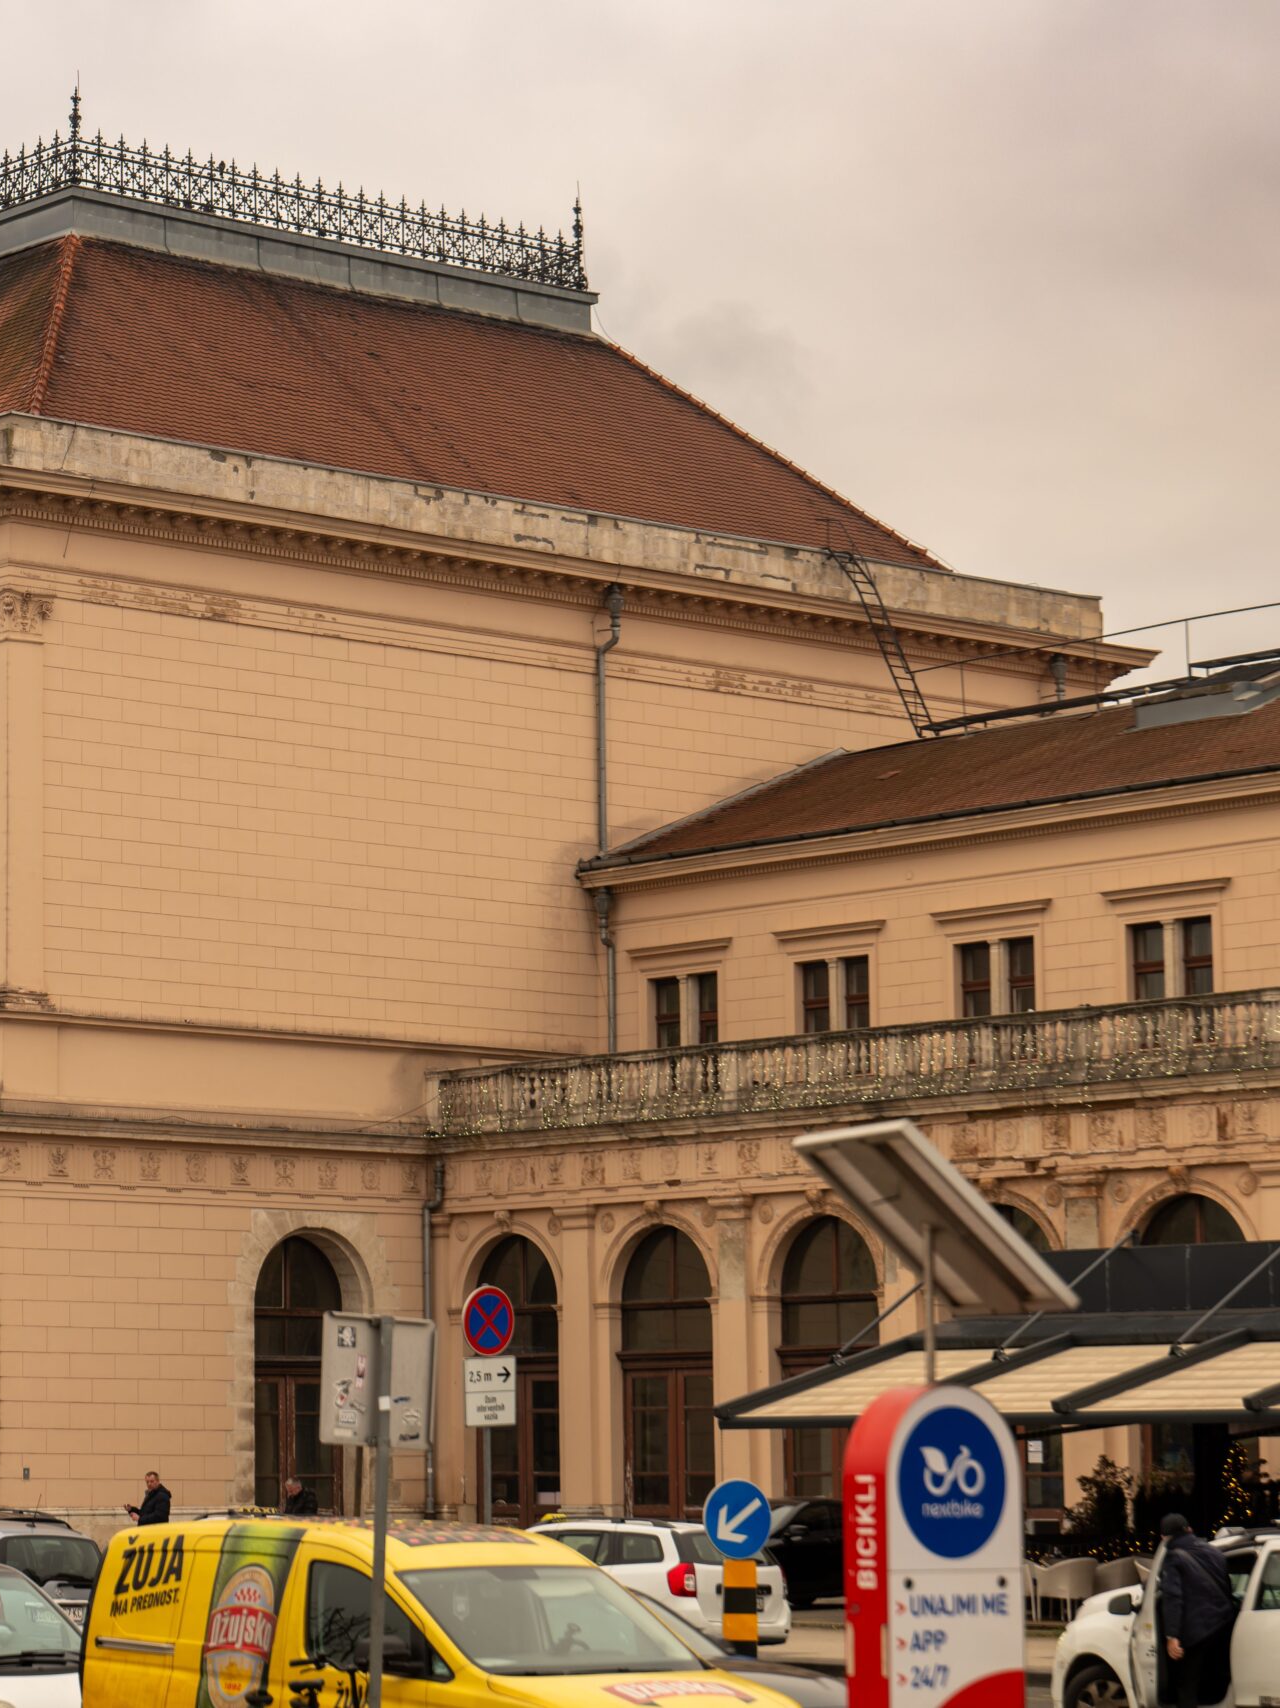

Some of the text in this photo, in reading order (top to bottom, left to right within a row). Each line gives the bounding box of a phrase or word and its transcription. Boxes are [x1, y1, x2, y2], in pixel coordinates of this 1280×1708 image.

[469, 1371, 492, 1383] 2,5 m
[921, 1499, 984, 1519] nextbike
[854, 1474, 878, 1591] BICIKLI
[114, 1534, 184, 1595] ŽUJA
[110, 1588, 179, 1617] IMA PREDNOST.
[909, 1592, 1008, 1616] UNAJMI ME
[910, 1629, 946, 1651] APP
[911, 1664, 949, 1689] 24/7
